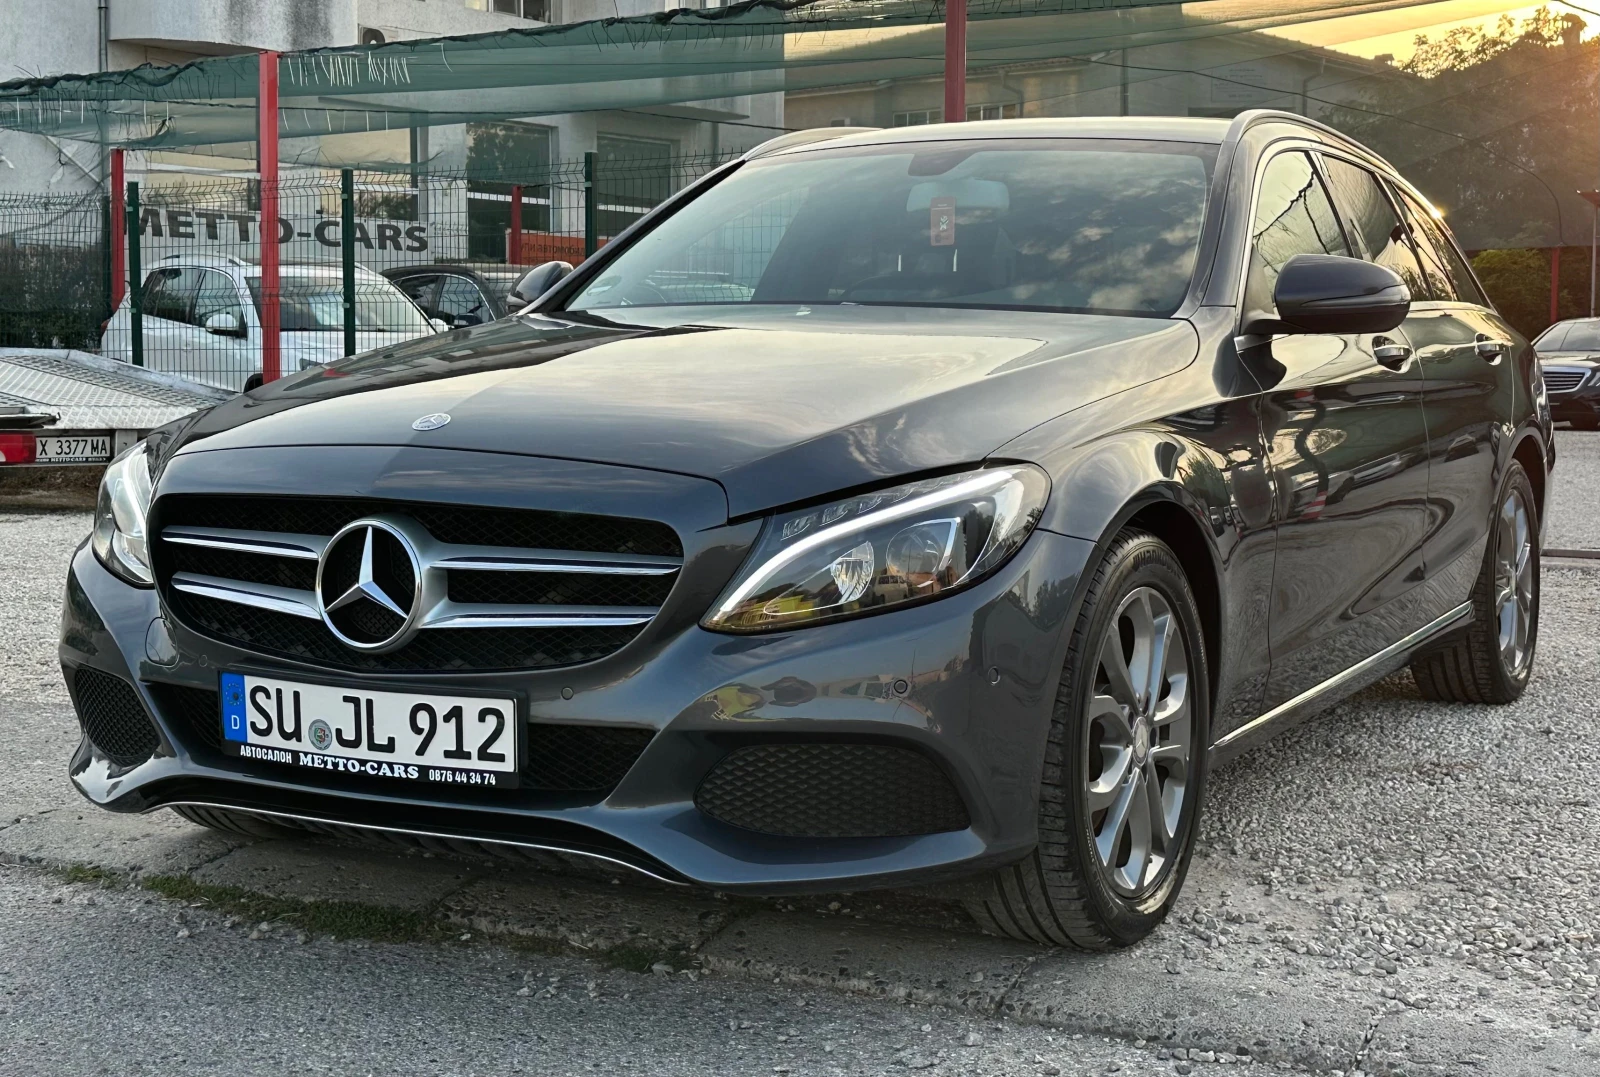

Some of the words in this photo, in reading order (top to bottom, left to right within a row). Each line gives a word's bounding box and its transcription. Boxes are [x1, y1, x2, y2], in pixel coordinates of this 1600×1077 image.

[39, 439, 48, 456] X
[55, 440, 88, 456] 3377
[91, 439, 107, 455] MA
[231, 715, 240, 730] D
[249, 685, 302, 743] SU
[334, 695, 396, 754] JL
[409, 702, 506, 763] 912
[240, 745, 292, 764] АВТОСАЛОН
[299, 752, 419, 780] METTO-CARS
[428, 768, 453, 782] 0876
[454, 770, 468, 784] 44
[469, 771, 482, 785] 34
[482, 772, 496, 786] 74
